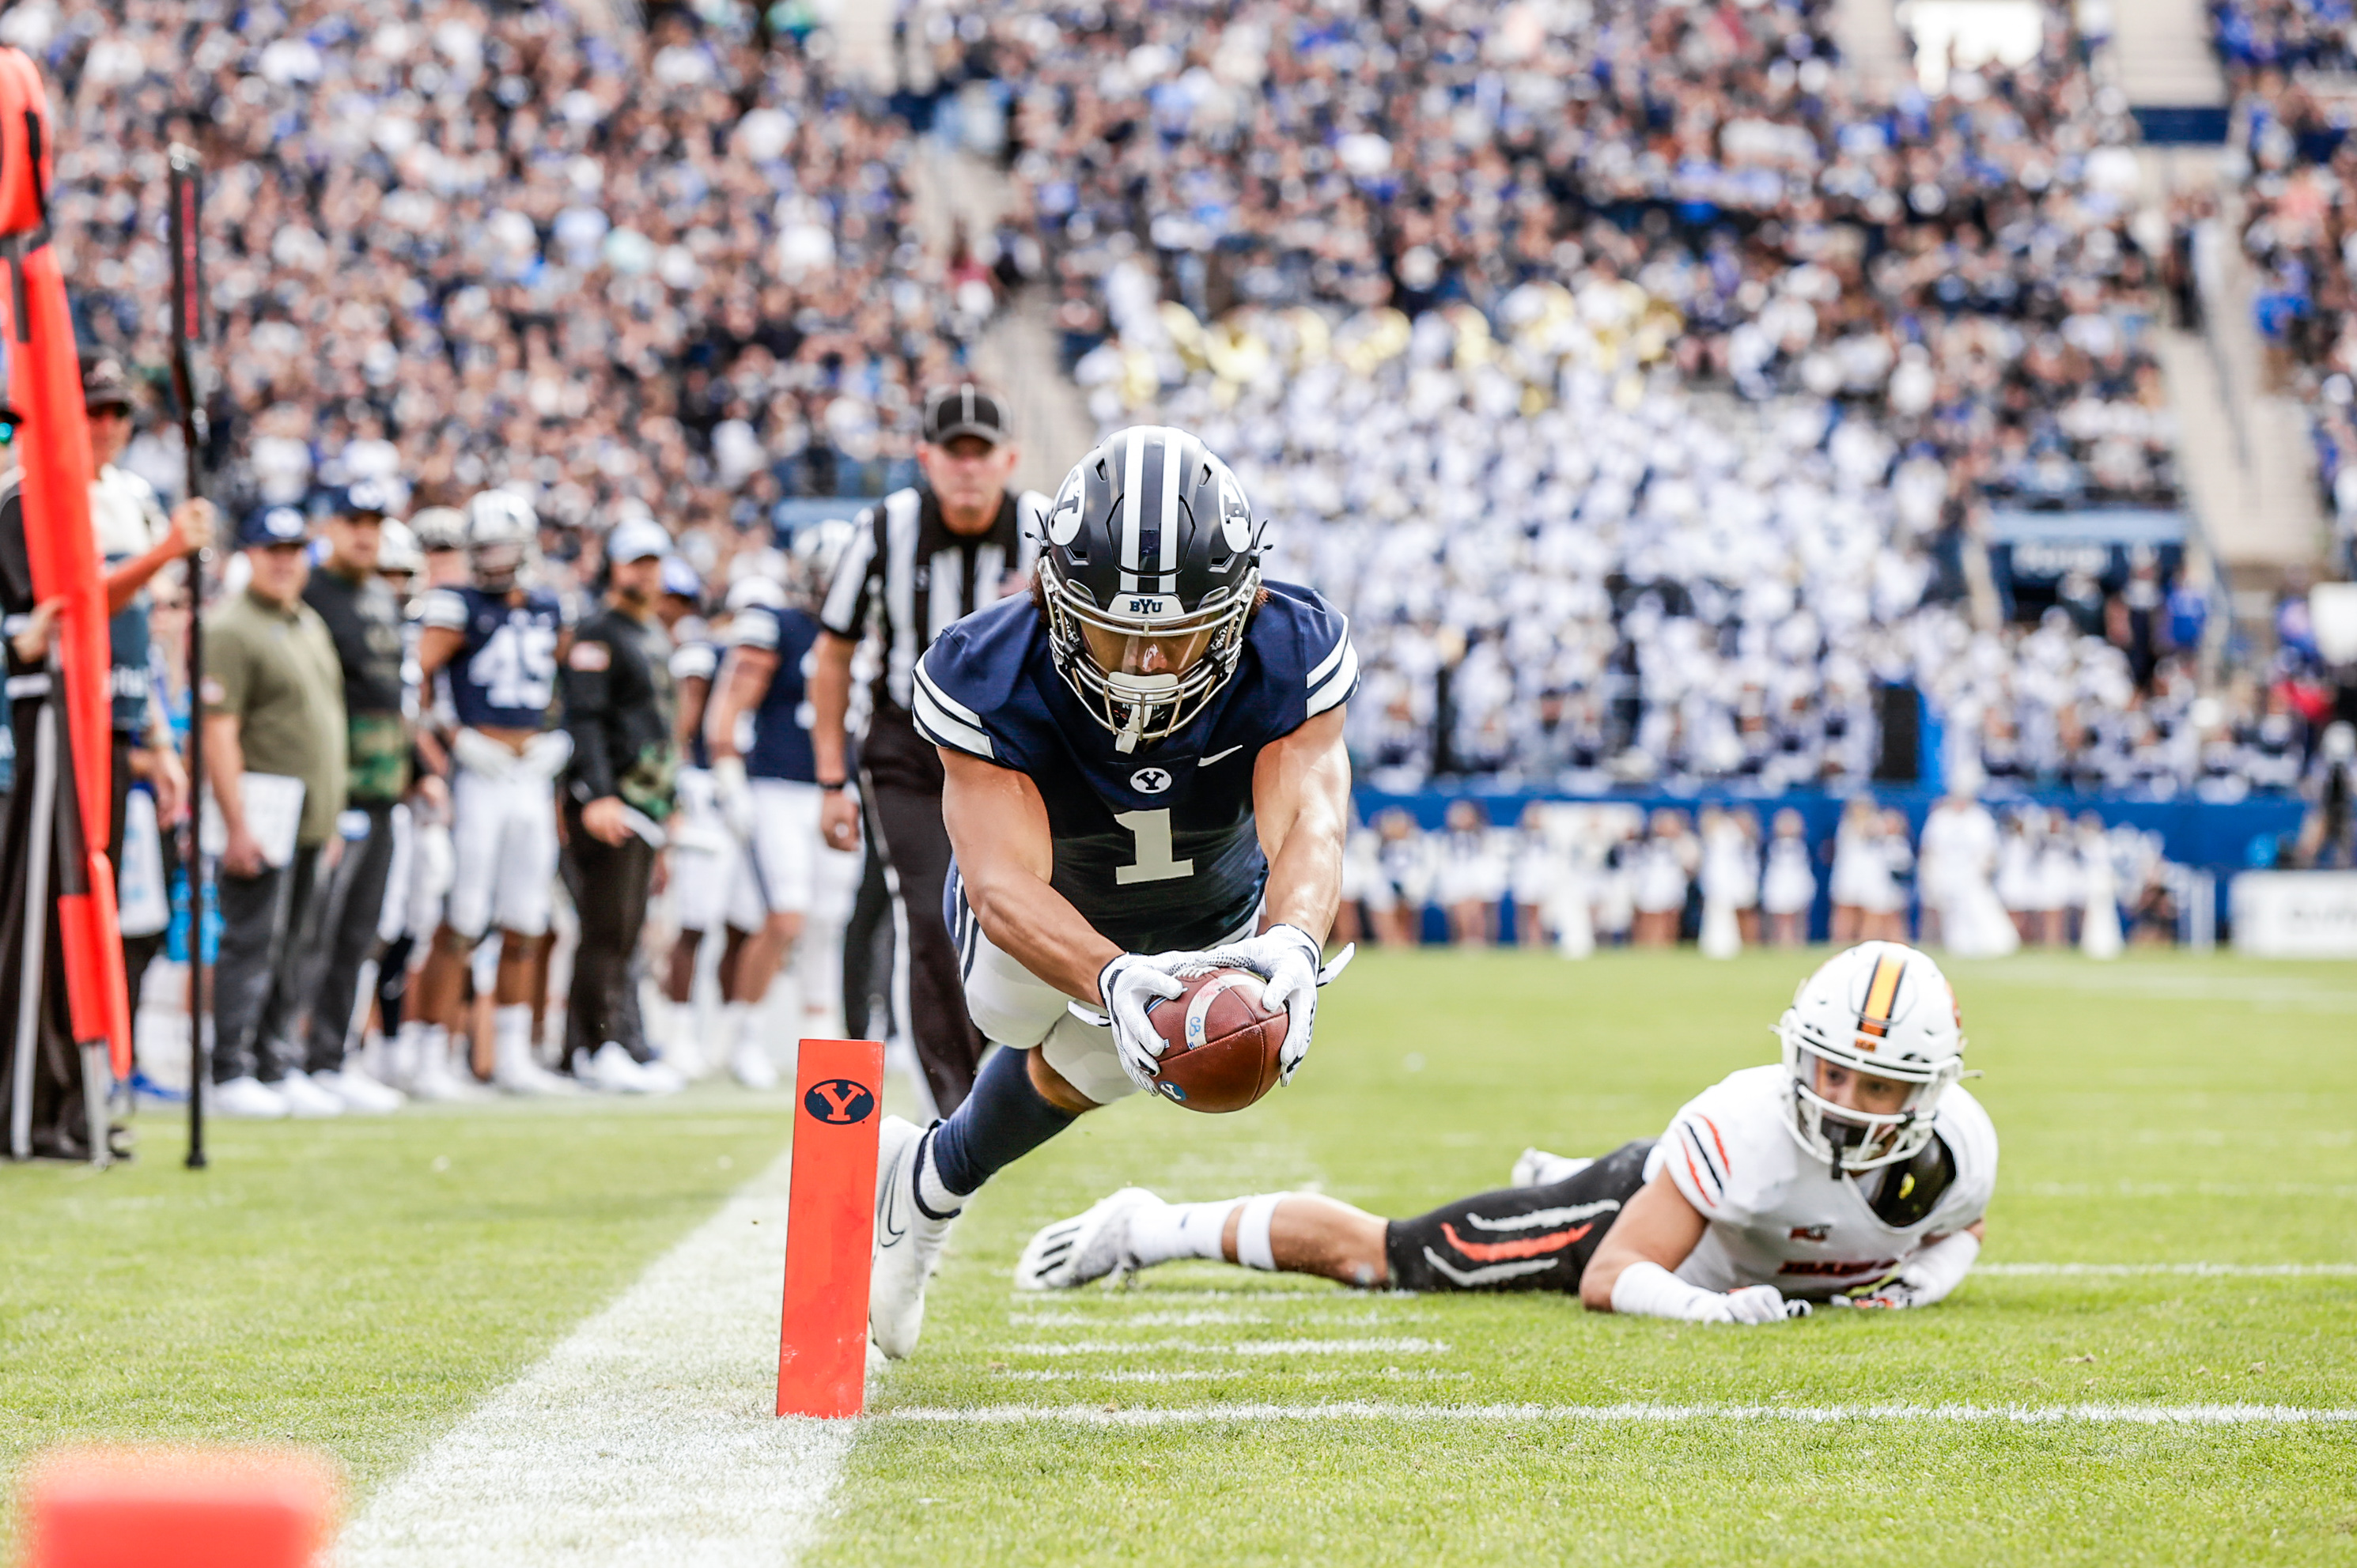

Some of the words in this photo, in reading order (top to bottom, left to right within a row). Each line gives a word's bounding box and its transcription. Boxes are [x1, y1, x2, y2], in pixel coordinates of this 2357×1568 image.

[1129, 598, 1163, 614] BYU
[467, 623, 558, 710] 45
[1136, 771, 1165, 791] Y
[1114, 807, 1194, 886] 1
[813, 1082, 866, 1121] Y
[1160, 1083, 1182, 1100] Y
